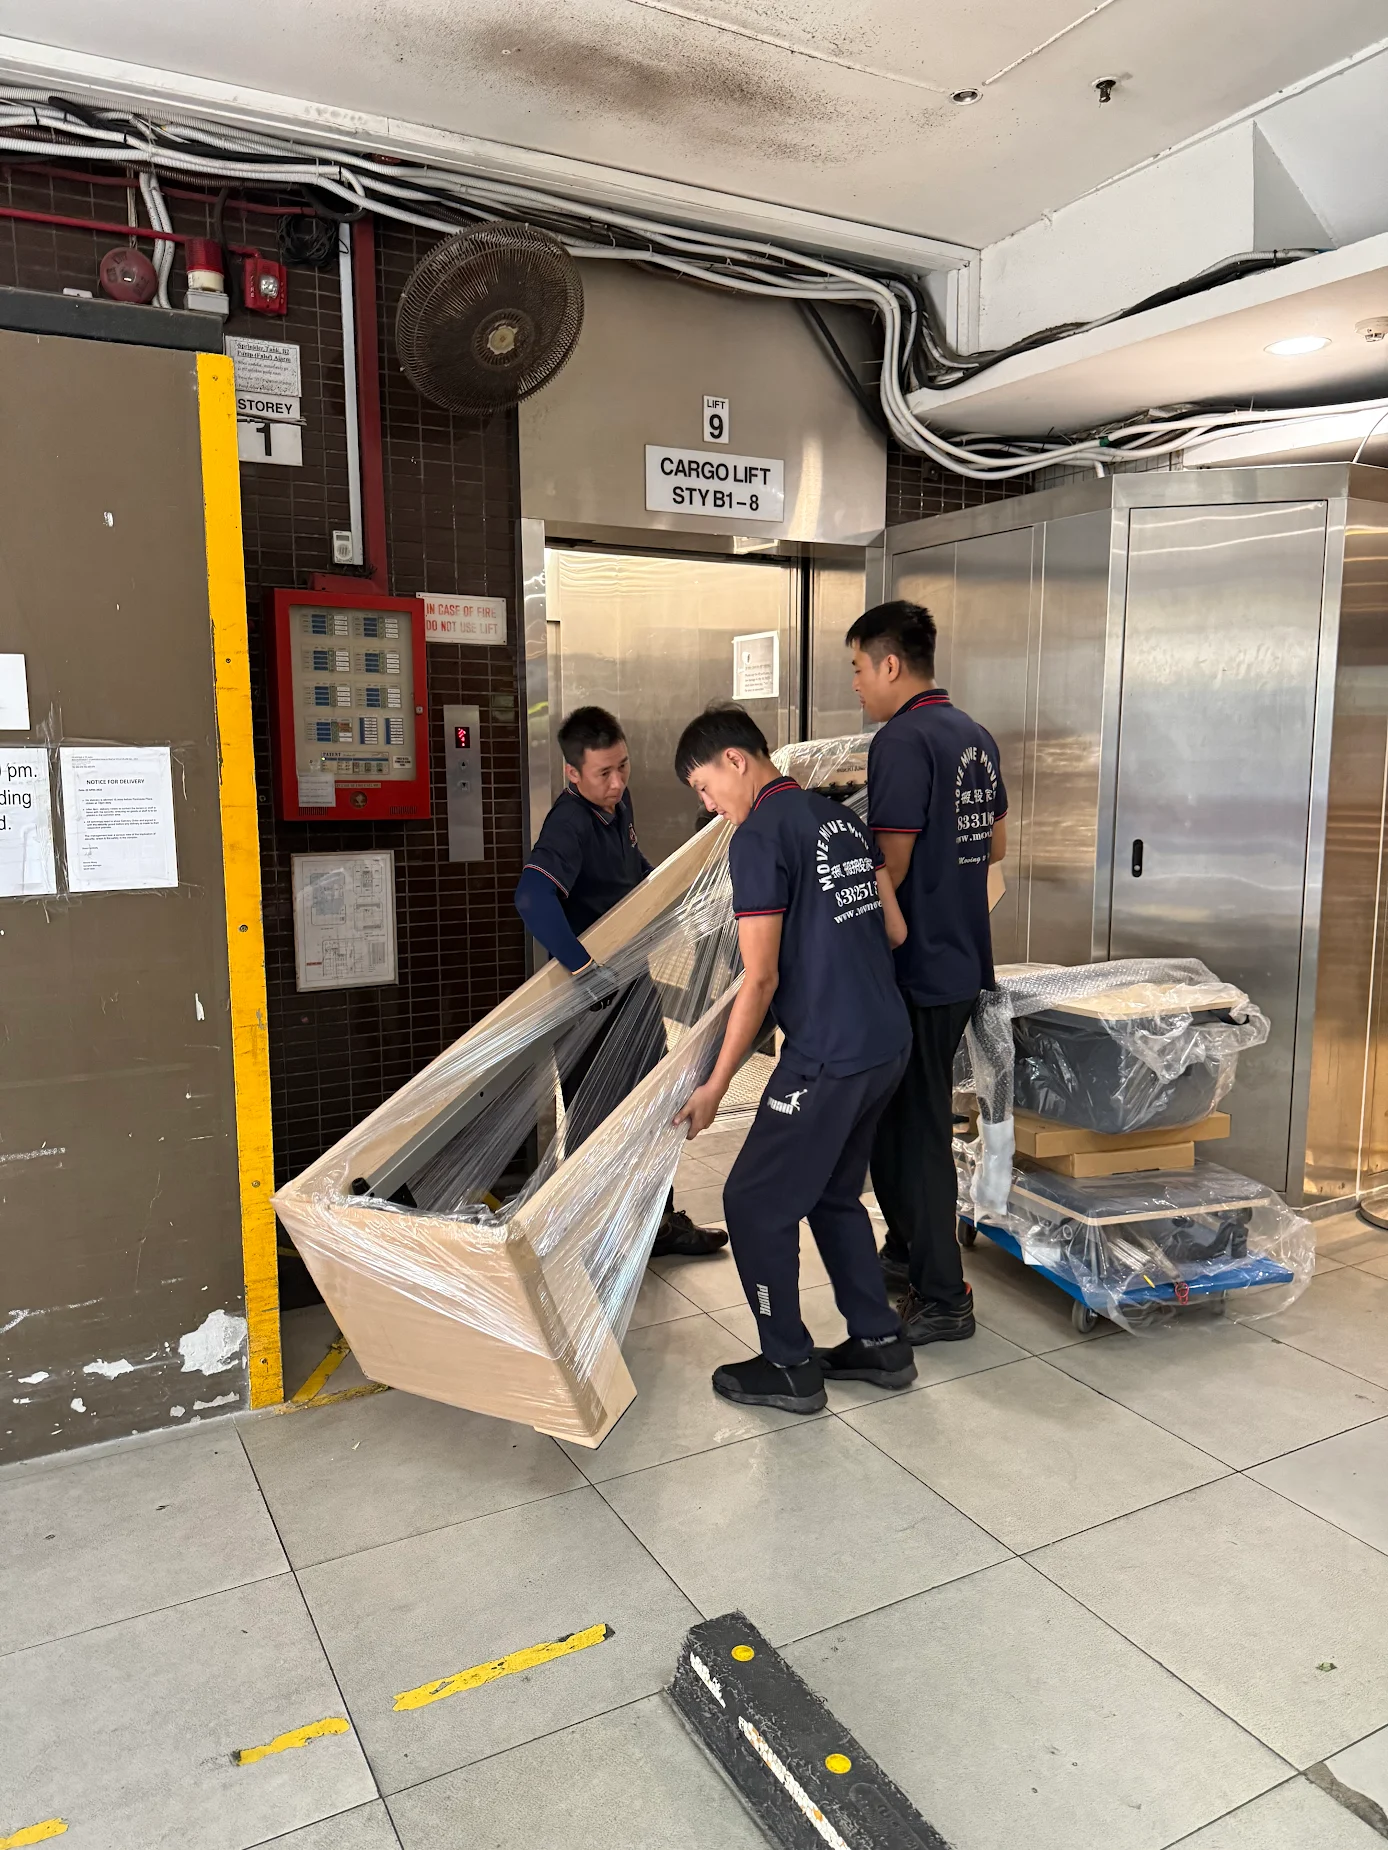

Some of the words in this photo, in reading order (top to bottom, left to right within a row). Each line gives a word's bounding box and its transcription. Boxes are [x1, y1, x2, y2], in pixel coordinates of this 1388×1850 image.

[237, 398, 293, 415] STOREY
[706, 399, 726, 409] LIFT
[709, 414, 724, 439] 9
[256, 421, 272, 457] 1
[660, 457, 729, 481] CARGO
[733, 464, 771, 485] LIFT
[672, 486, 710, 507] STY
[426, 603, 435, 615] IN
[438, 603, 460, 617] CASE
[463, 605, 474, 618] OF
[477, 606, 497, 619] FIRE
[426, 620, 438, 632] DO
[441, 621, 457, 633] NOT
[460, 622, 477, 634] USE
[480, 623, 498, 635] LIFT
[8, 765, 37, 781] pm.
[0, 789, 31, 808] ding
[816, 839, 836, 892] MOVE
[756, 1283, 771, 1317] PUMA
